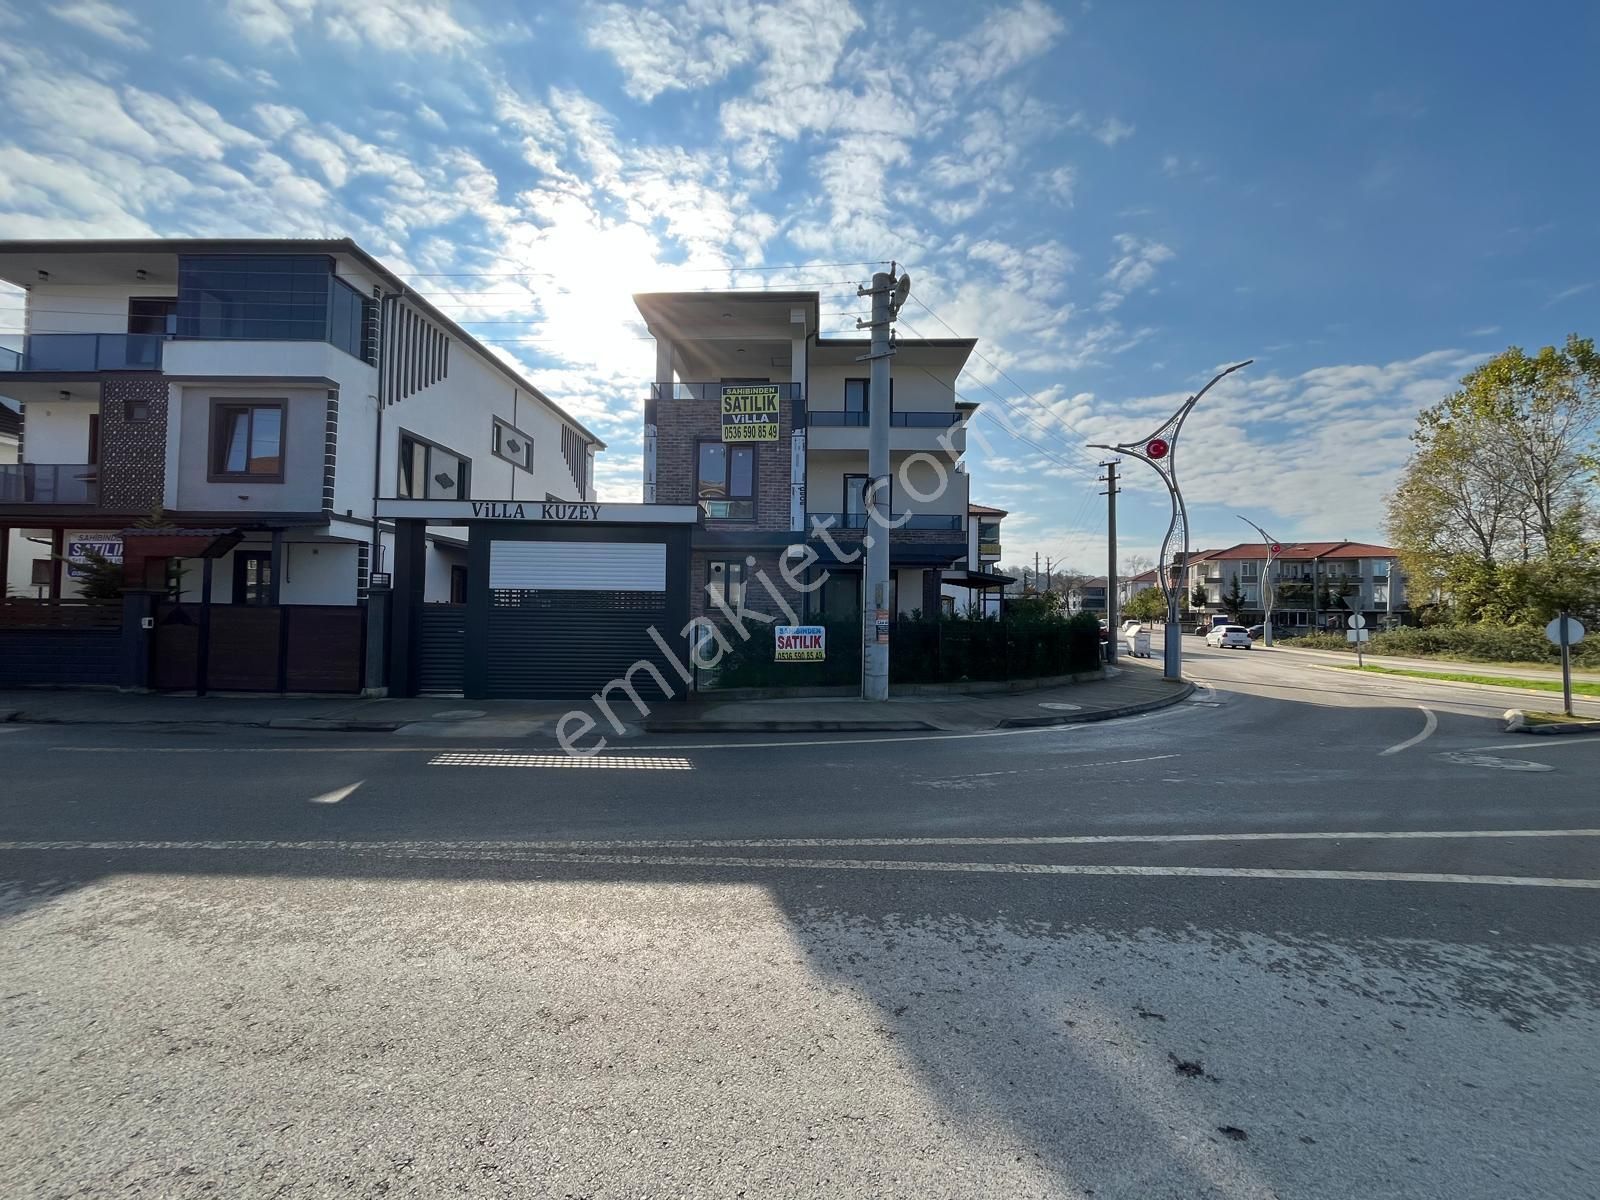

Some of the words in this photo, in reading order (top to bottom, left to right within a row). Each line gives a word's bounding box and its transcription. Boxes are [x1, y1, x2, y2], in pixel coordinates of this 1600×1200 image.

[724, 395, 777, 413] SATILIK
[724, 426, 742, 440] 0536
[743, 425, 756, 439] 590
[757, 425, 767, 439] 85
[768, 425, 777, 439] 49
[541, 504, 602, 521] KUZEY
[777, 635, 822, 650] SATILIK
